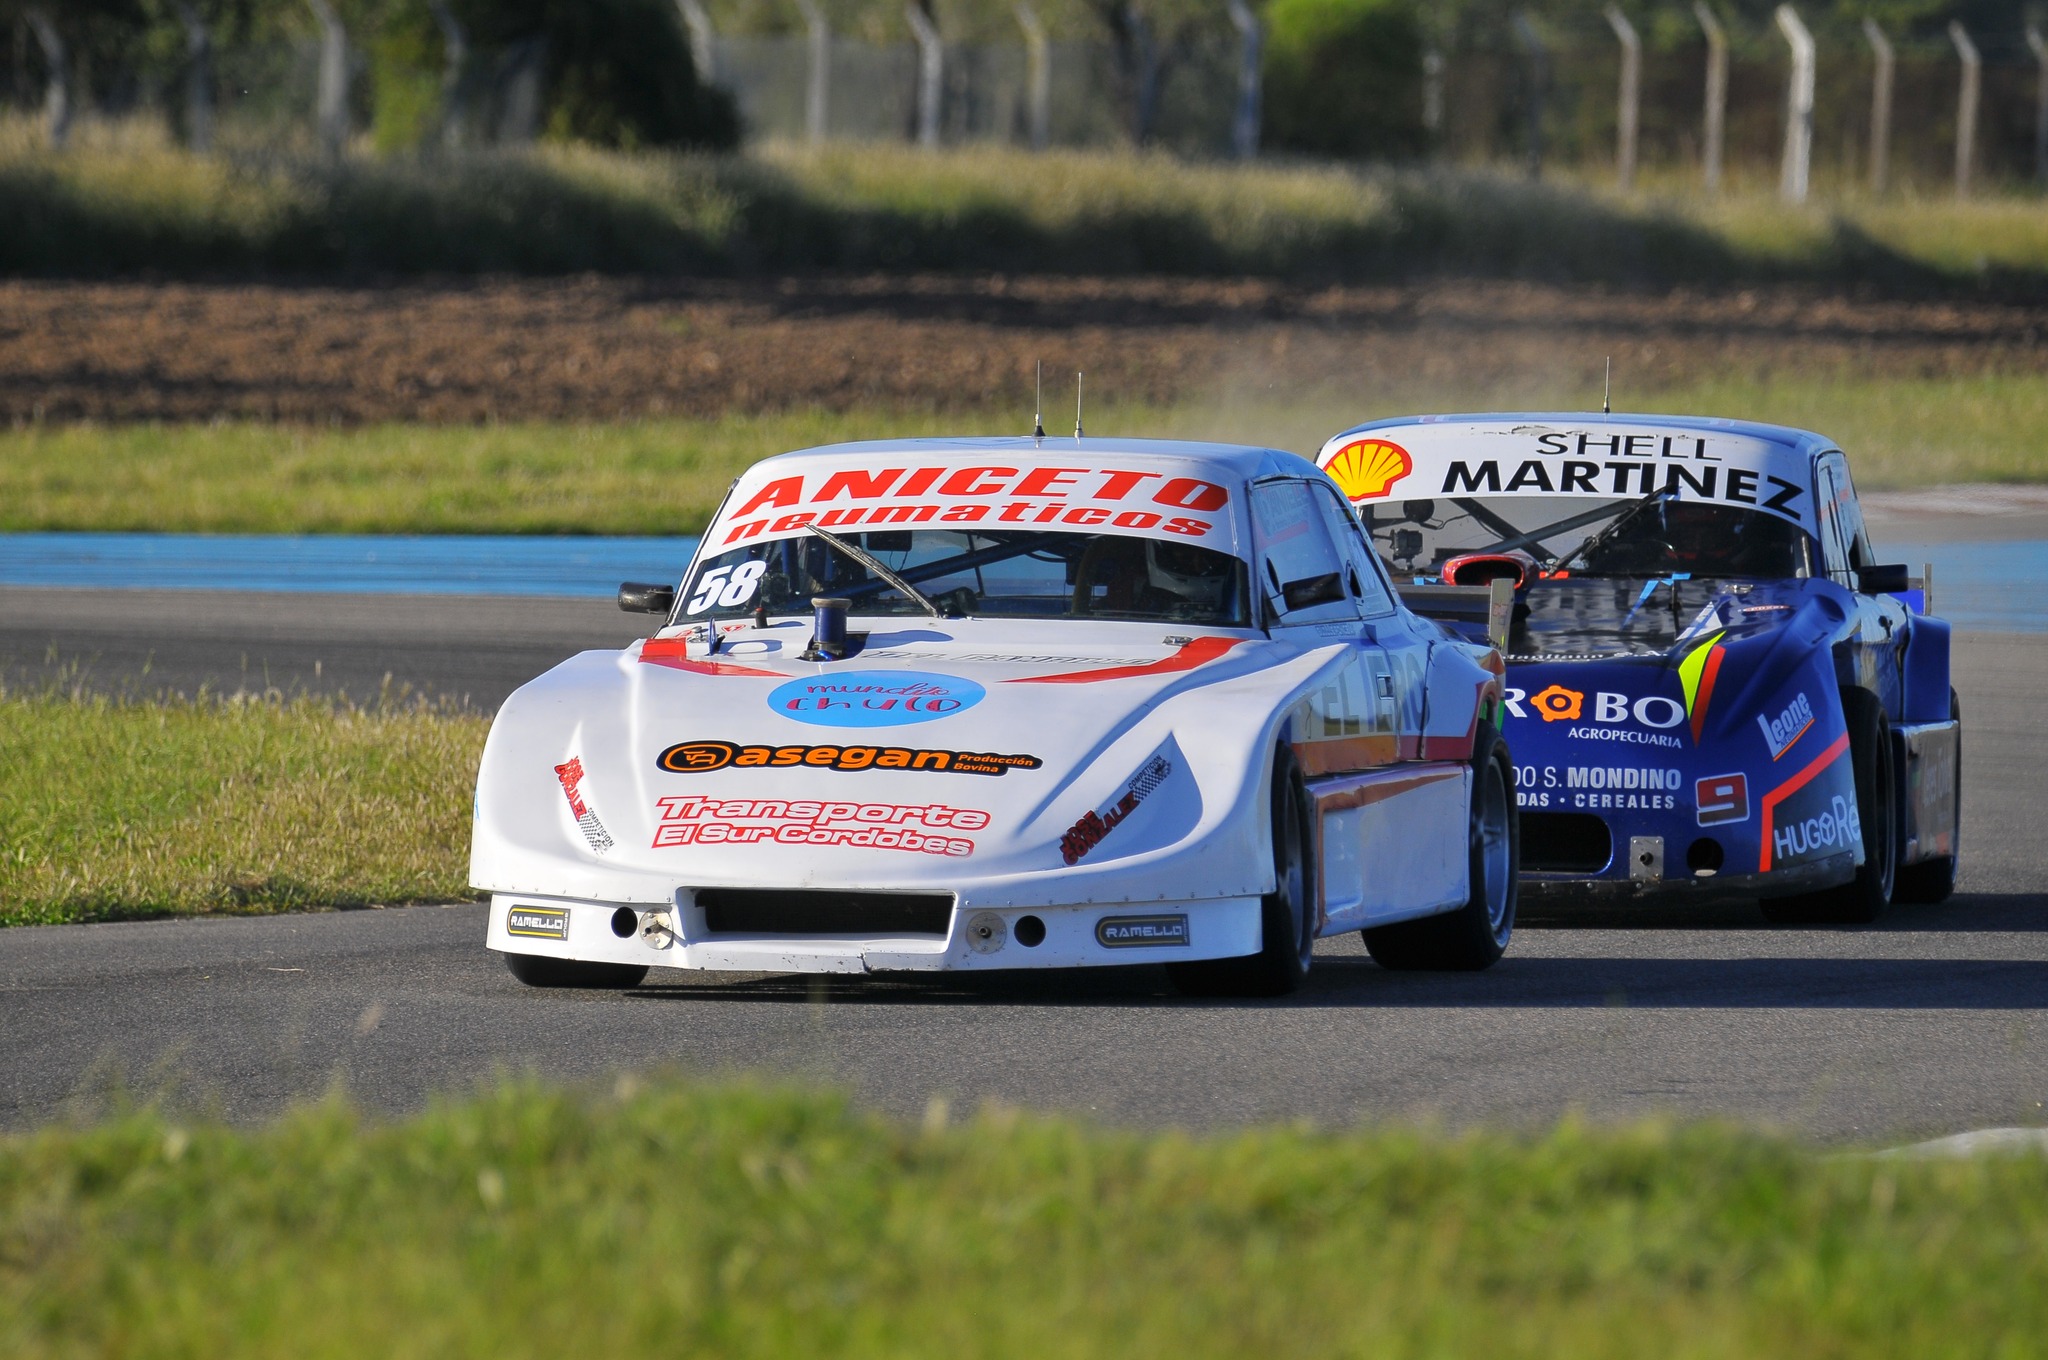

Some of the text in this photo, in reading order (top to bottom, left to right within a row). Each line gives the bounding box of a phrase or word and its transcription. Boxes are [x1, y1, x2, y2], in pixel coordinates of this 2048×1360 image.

[1536, 433, 1722, 461] SHELL
[730, 467, 1229, 519] ANICETO
[1442, 460, 1804, 521] MARTINEZ
[722, 502, 1213, 545] neumaticos
[687, 560, 766, 615] 58
[1568, 727, 1682, 749] AGROPECUARIA
[1757, 692, 1810, 758] Leone
[735, 745, 950, 769] asegan
[953, 764, 999, 774] Bovina
[958, 754, 1034, 767] Producción
[1567, 767, 1682, 790] MONDINO
[657, 796, 991, 831] Transporte
[1575, 794, 1675, 809] CEREALES
[1696, 772, 1750, 828] 9
[652, 823, 976, 858] El Sur Cordobes
[510, 915, 564, 930] RAMELLO
[1105, 926, 1183, 938] RAMELLO
